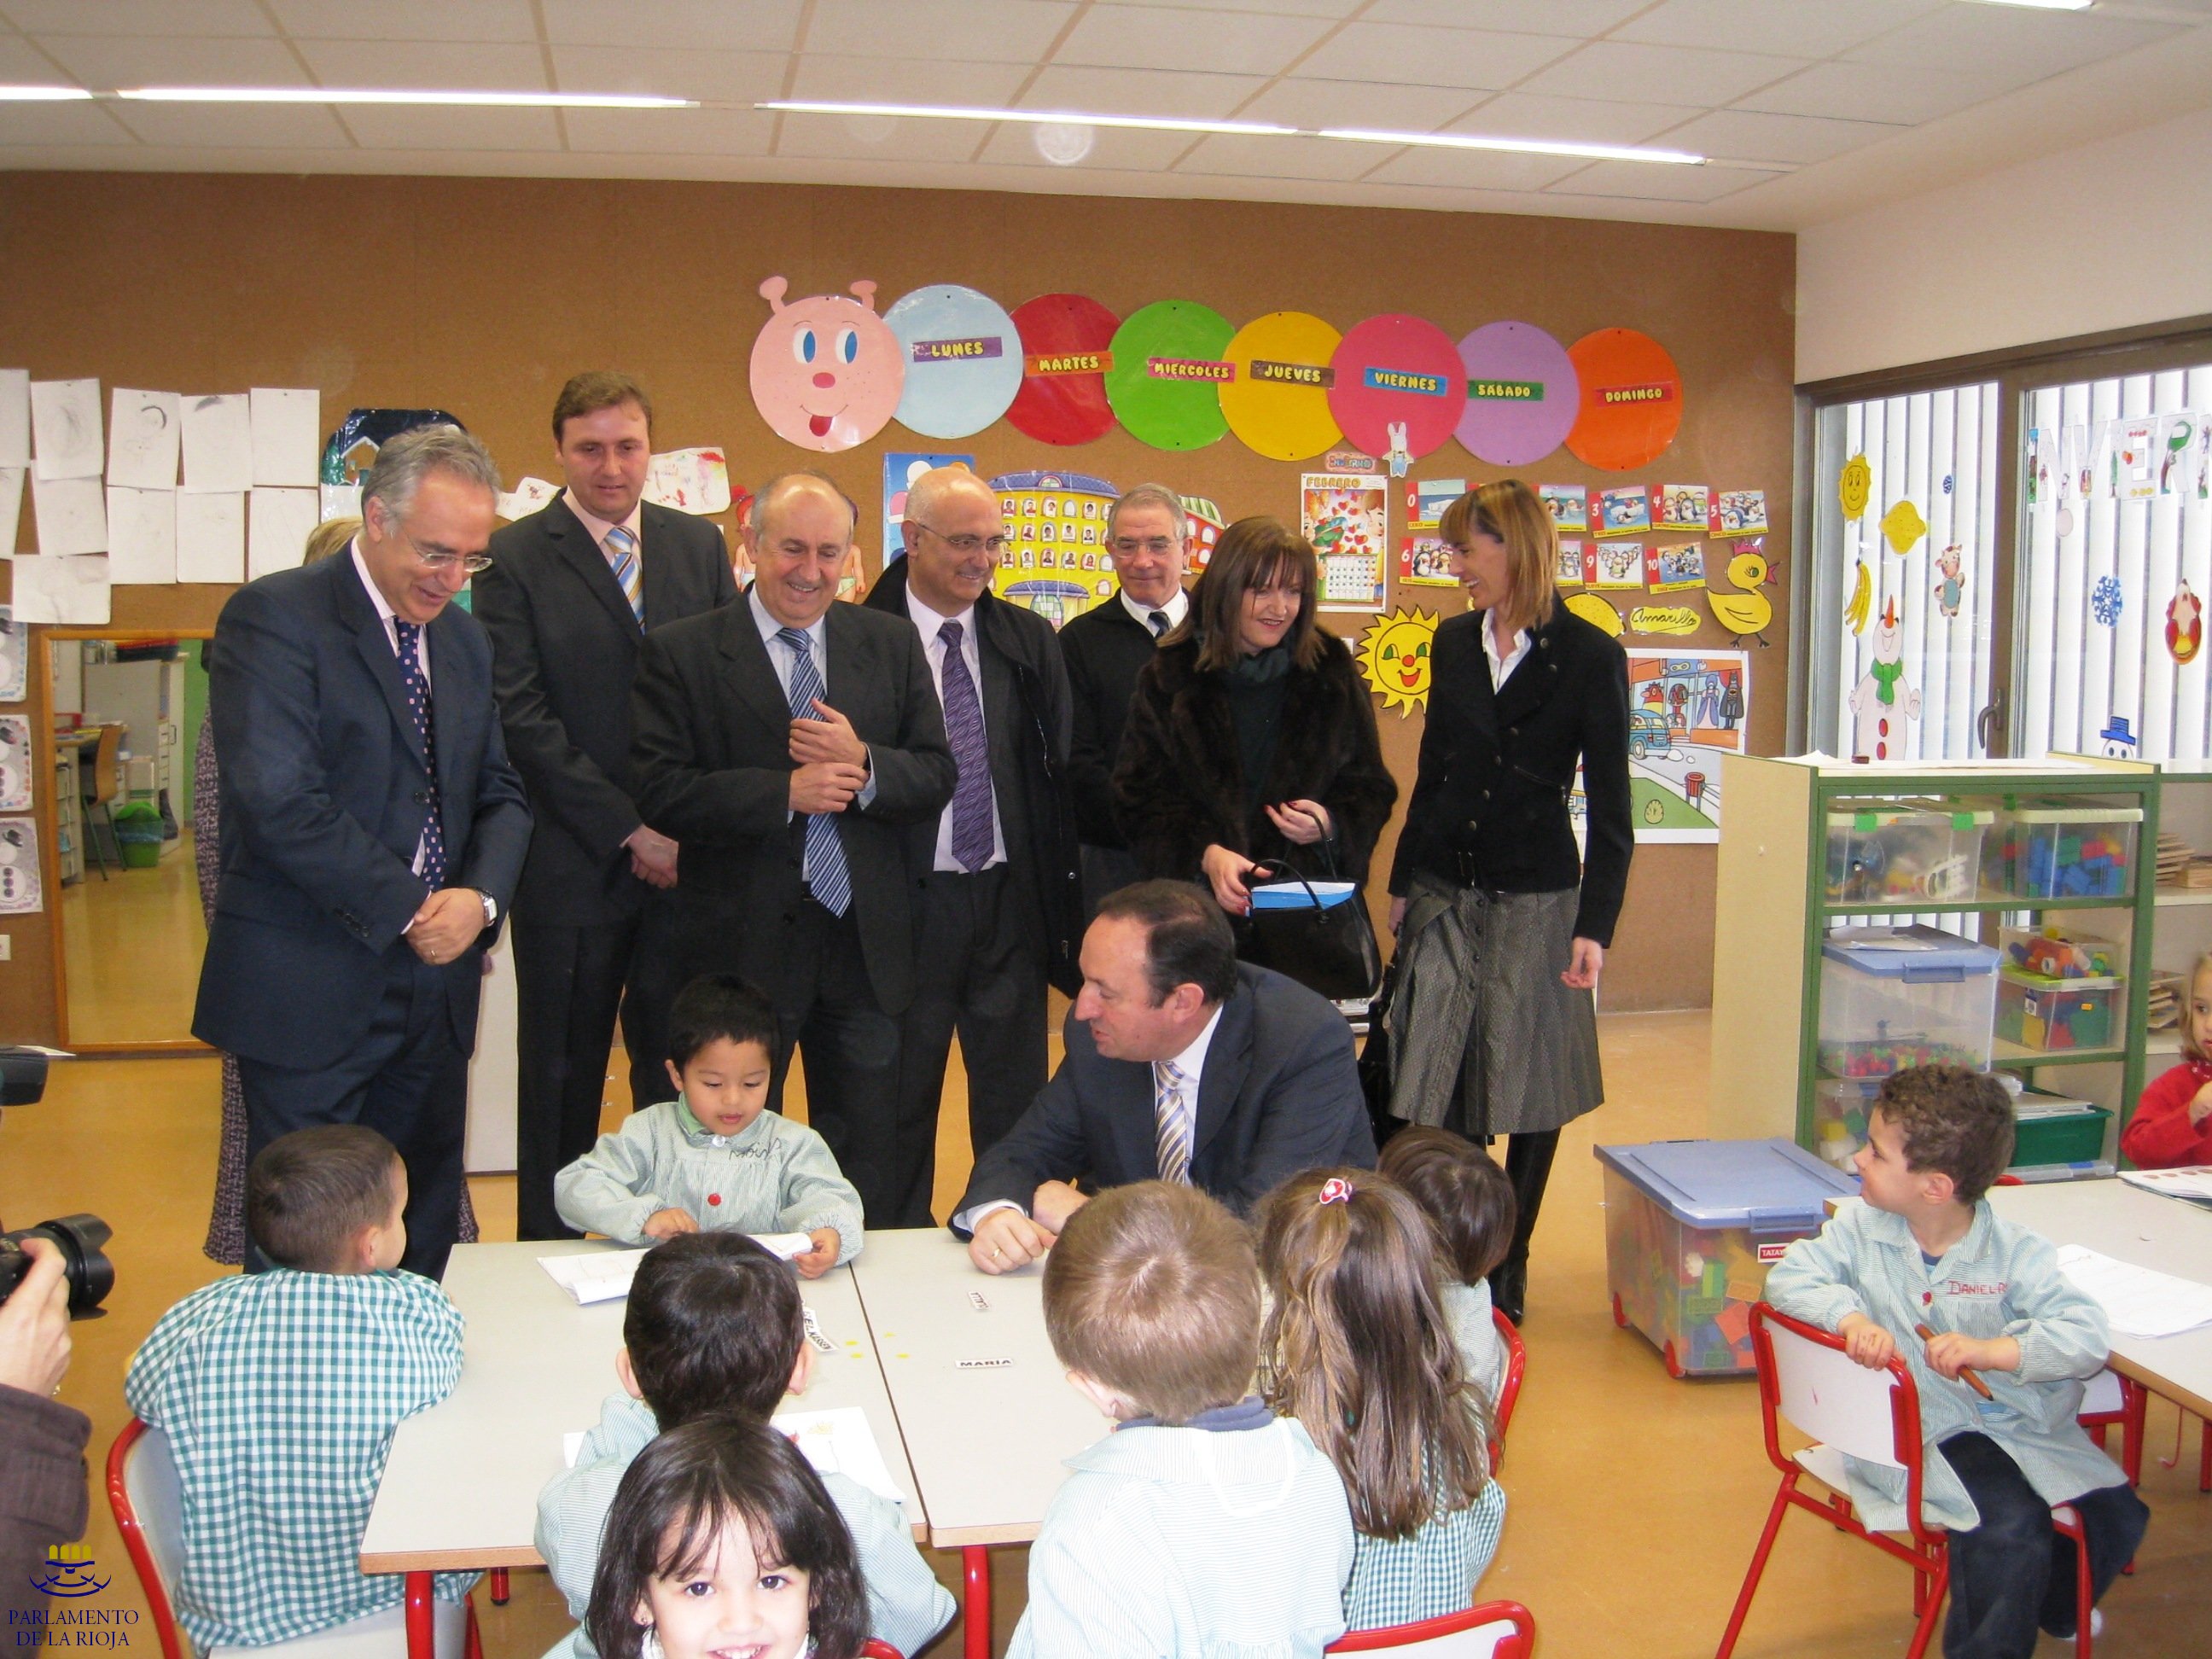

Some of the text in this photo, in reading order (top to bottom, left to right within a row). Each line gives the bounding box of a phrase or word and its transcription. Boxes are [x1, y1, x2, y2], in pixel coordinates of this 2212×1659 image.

[931, 341, 984, 357] LUNES
[1039, 355, 1099, 372] MARTES
[1264, 364, 1321, 383] JUEVES
[1375, 372, 1437, 392] VIERNES
[1605, 387, 1663, 404] DOMINGO
[1307, 476, 1361, 489] FEBRERO
[1407, 493, 1416, 508] 0
[1653, 496, 1661, 509] 4
[1592, 503, 1599, 517] 3
[1710, 504, 1718, 518] 5
[1401, 549, 1410, 562] 6
[1586, 555, 1595, 568] 9
[1646, 559, 1658, 571] 10
